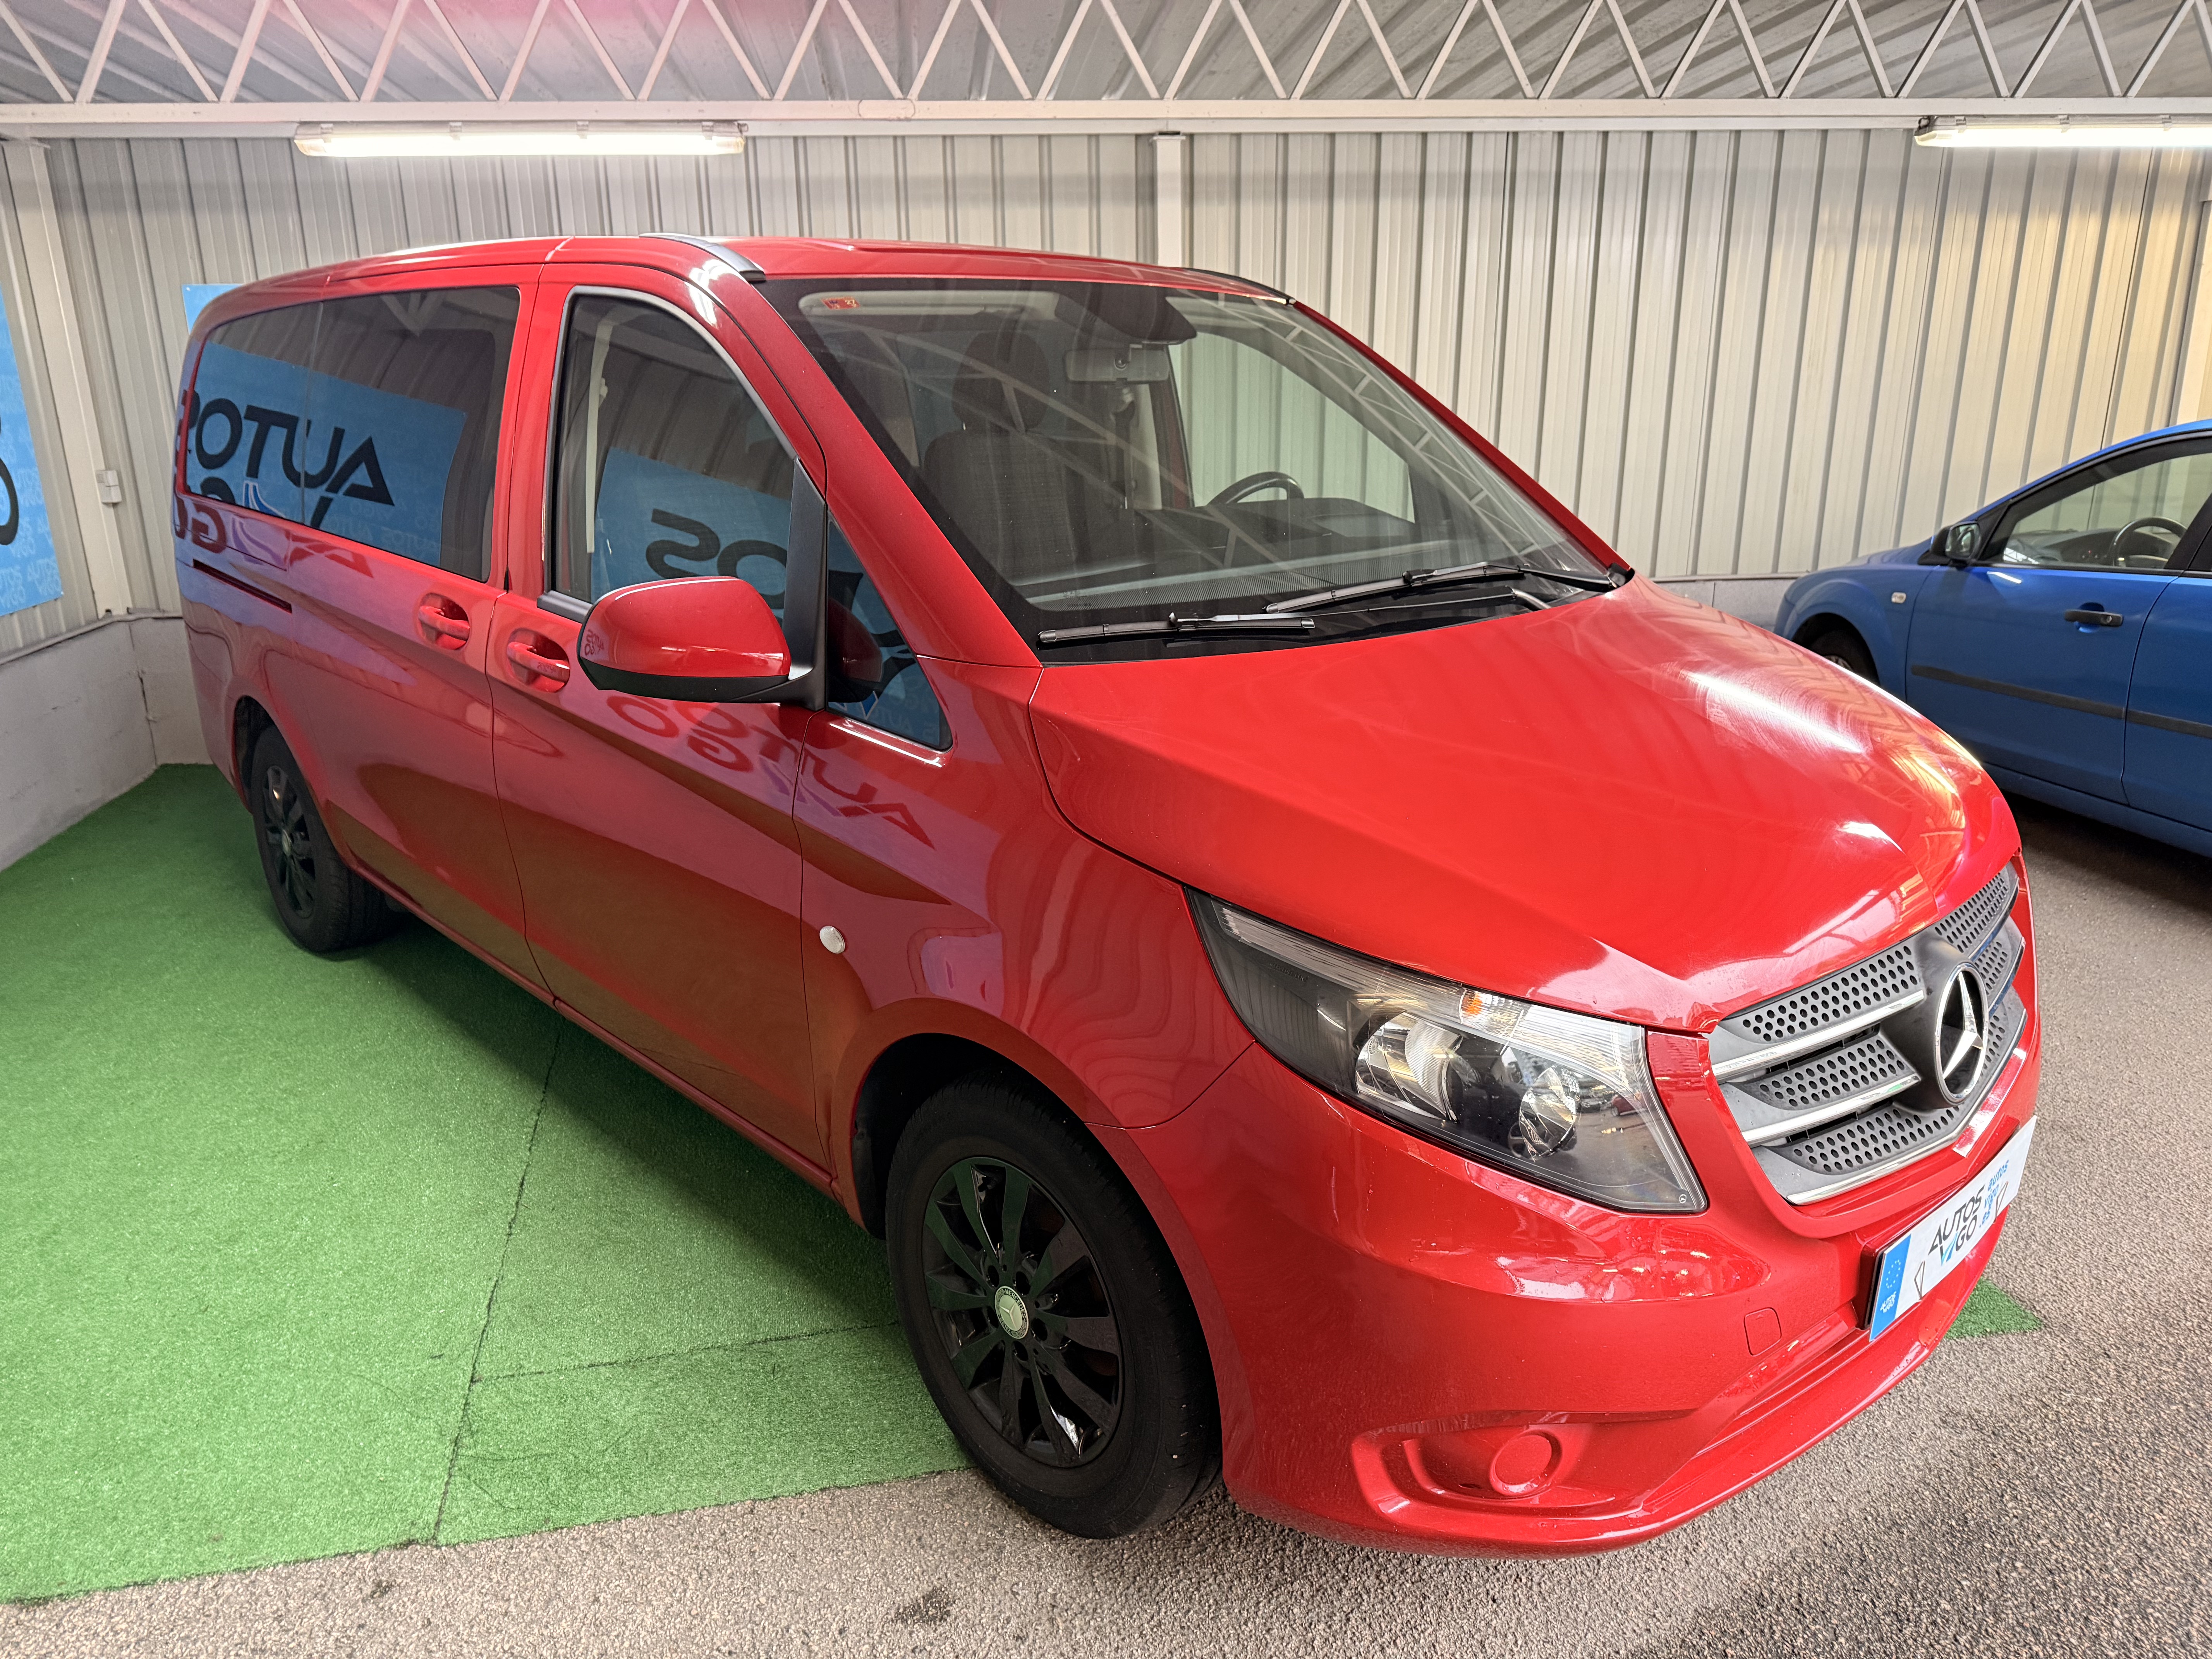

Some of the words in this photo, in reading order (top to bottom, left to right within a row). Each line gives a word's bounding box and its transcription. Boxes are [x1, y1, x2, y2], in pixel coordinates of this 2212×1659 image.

[1987, 1159, 2009, 1192] autos
[1928, 1184, 1985, 1255] AUTOS
[1005, 1288, 1027, 1319] MERCEDES
